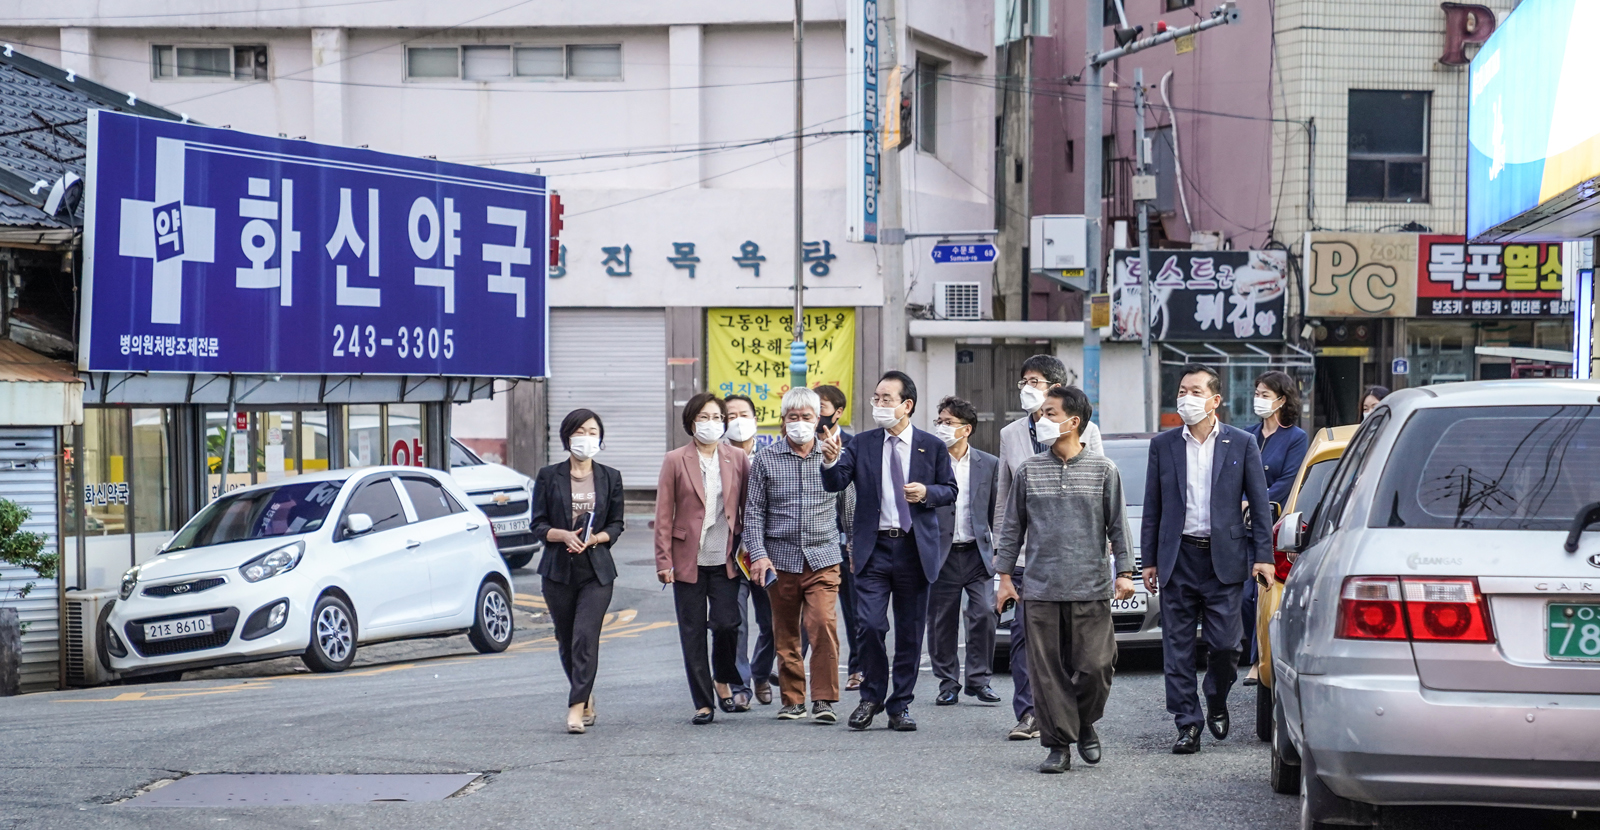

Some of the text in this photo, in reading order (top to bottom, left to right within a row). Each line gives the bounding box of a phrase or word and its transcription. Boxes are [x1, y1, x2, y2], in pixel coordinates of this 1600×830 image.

[155, 207, 180, 251] 약
[235, 177, 532, 318] 화신약국
[933, 250, 942, 258] 72
[984, 249, 994, 257] 68
[1370, 242, 1417, 261] ZONE
[1310, 241, 1397, 313] PC
[1432, 300, 1462, 314] 보조키
[1472, 300, 1501, 314] 번호키
[1511, 300, 1540, 314] 인터폰
[719, 314, 771, 332] 그동안
[119, 334, 219, 358] 병의원처방조제전문
[332, 323, 455, 360] 243-3305
[736, 360, 824, 379] 감사합다.
[84, 483, 129, 505] 화신약국
[509, 520, 526, 530] 1873
[150, 619, 206, 637] 21조 8610
